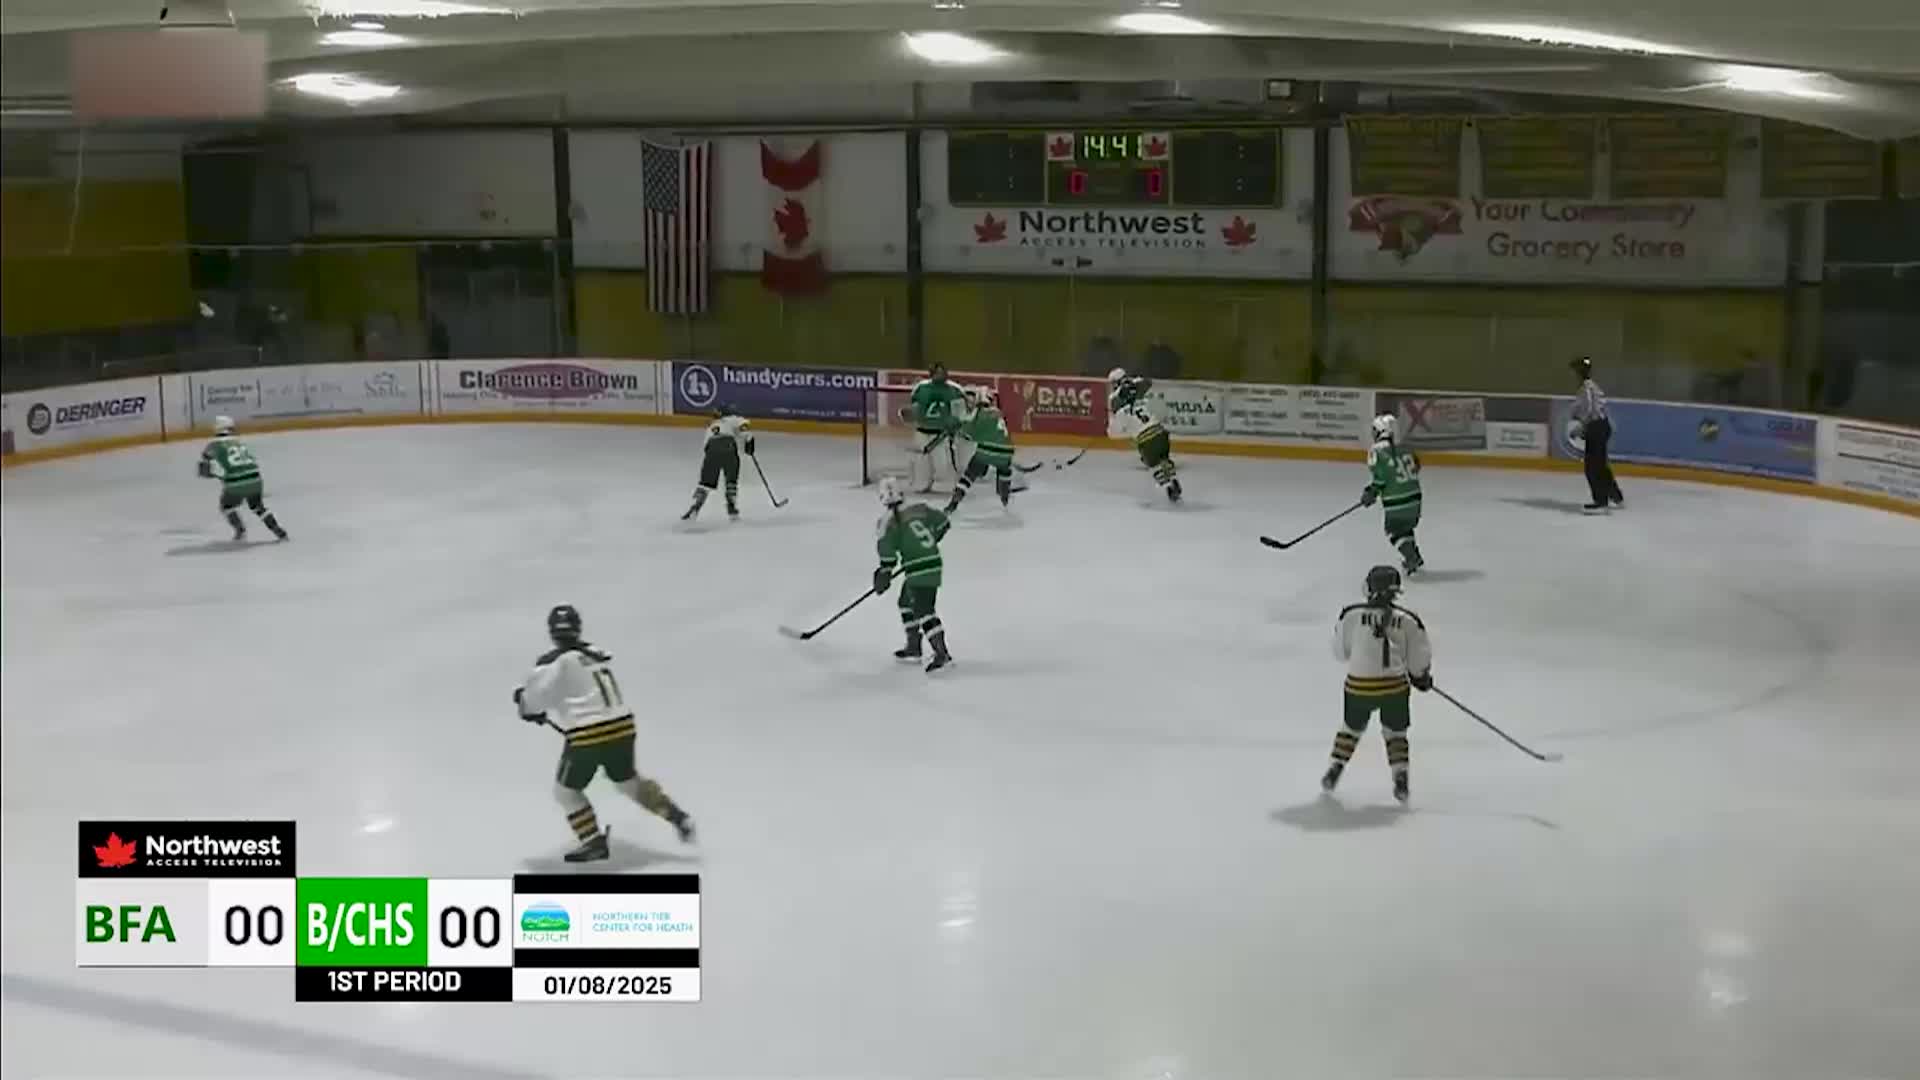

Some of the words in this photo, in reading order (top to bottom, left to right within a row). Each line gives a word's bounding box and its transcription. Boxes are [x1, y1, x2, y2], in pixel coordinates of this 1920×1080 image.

[1472, 196, 1530, 221] Your
[1019, 210, 1206, 234] Northwest
[1020, 236, 1087, 247] ACCESS
[1098, 237, 1206, 249] TELEVISION
[1487, 231, 1600, 264] Grocery
[1612, 232, 1686, 257] Store
[459, 371, 562, 390] Clarence
[569, 371, 639, 390] Brown
[723, 367, 875, 389] handycars.com
[1037, 387, 1092, 407] DMC
[56, 397, 146, 424] DERINGER
[909, 519, 936, 548] 9
